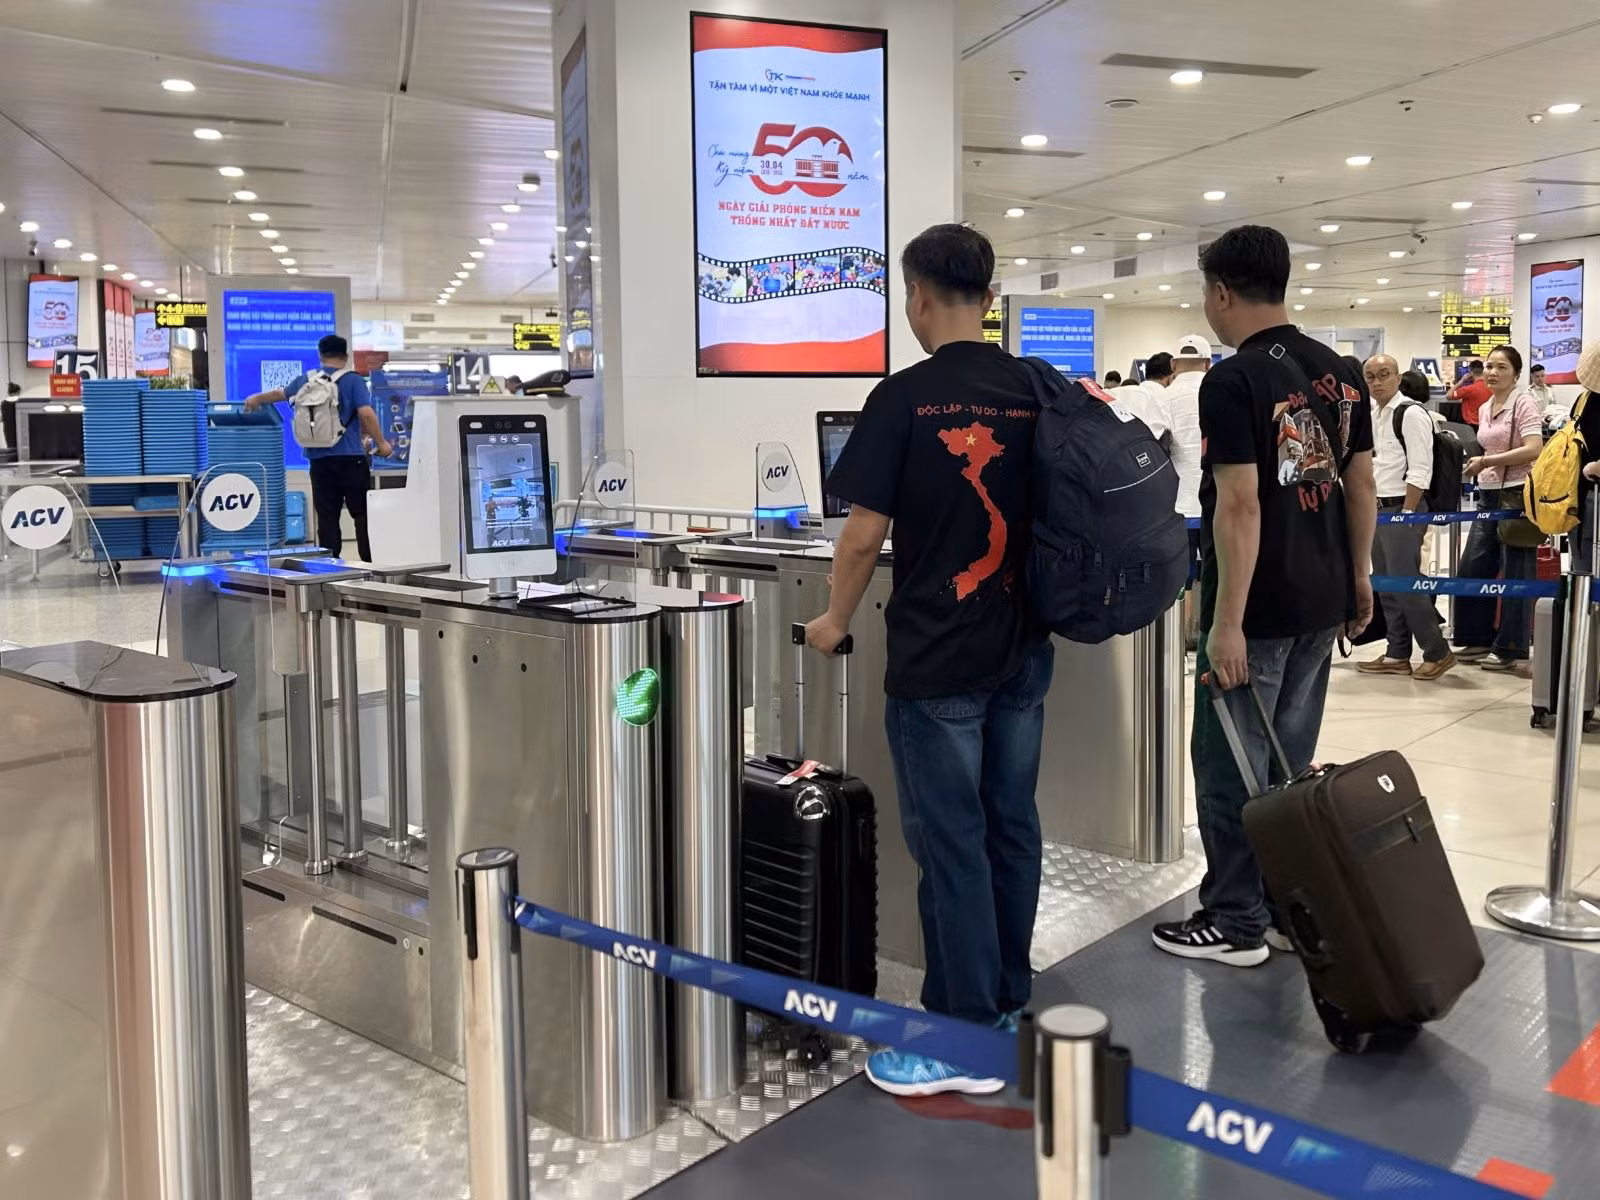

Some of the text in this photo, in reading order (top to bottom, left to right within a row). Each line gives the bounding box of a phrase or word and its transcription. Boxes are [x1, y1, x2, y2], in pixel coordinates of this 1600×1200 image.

[780, 86, 798, 96] VIỆT
[718, 200, 746, 211] NGÀY
[839, 208, 861, 217] NAM
[56, 354, 97, 380] 15
[917, 404, 941, 417] ĐỘC
[943, 403, 962, 415] LẬP
[970, 405, 983, 415] TỰ
[984, 407, 998, 416] DO
[1005, 408, 1031, 418] HẠNH
[766, 465, 789, 479] ACV
[598, 478, 627, 493] ACV
[209, 493, 254, 512] ACV
[10, 507, 65, 529] ACV
[1413, 580, 1438, 590] ACV
[1479, 583, 1507, 594] ACV
[613, 941, 657, 969] ACV
[784, 988, 838, 1022] ACV
[1186, 1101, 1274, 1154] ACV
